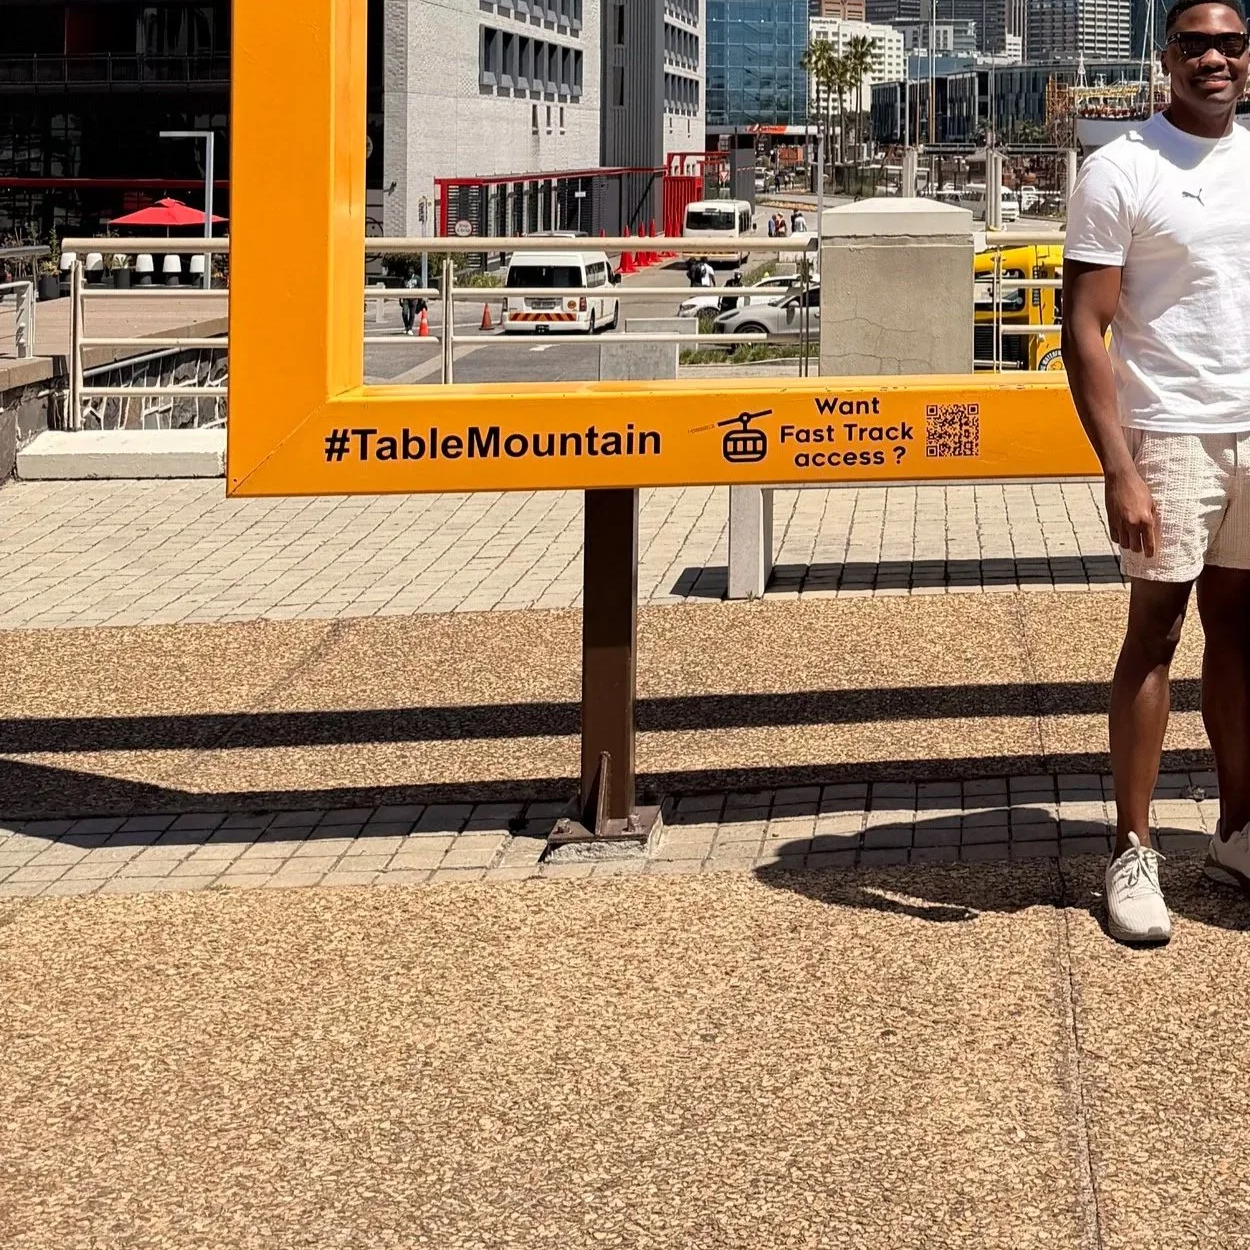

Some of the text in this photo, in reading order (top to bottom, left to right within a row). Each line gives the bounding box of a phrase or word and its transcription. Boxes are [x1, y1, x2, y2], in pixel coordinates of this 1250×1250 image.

[816, 398, 879, 414] Want
[781, 423, 912, 442] Fast Track
[325, 425, 660, 461] #TableMountain
[795, 446, 905, 466] access ?
